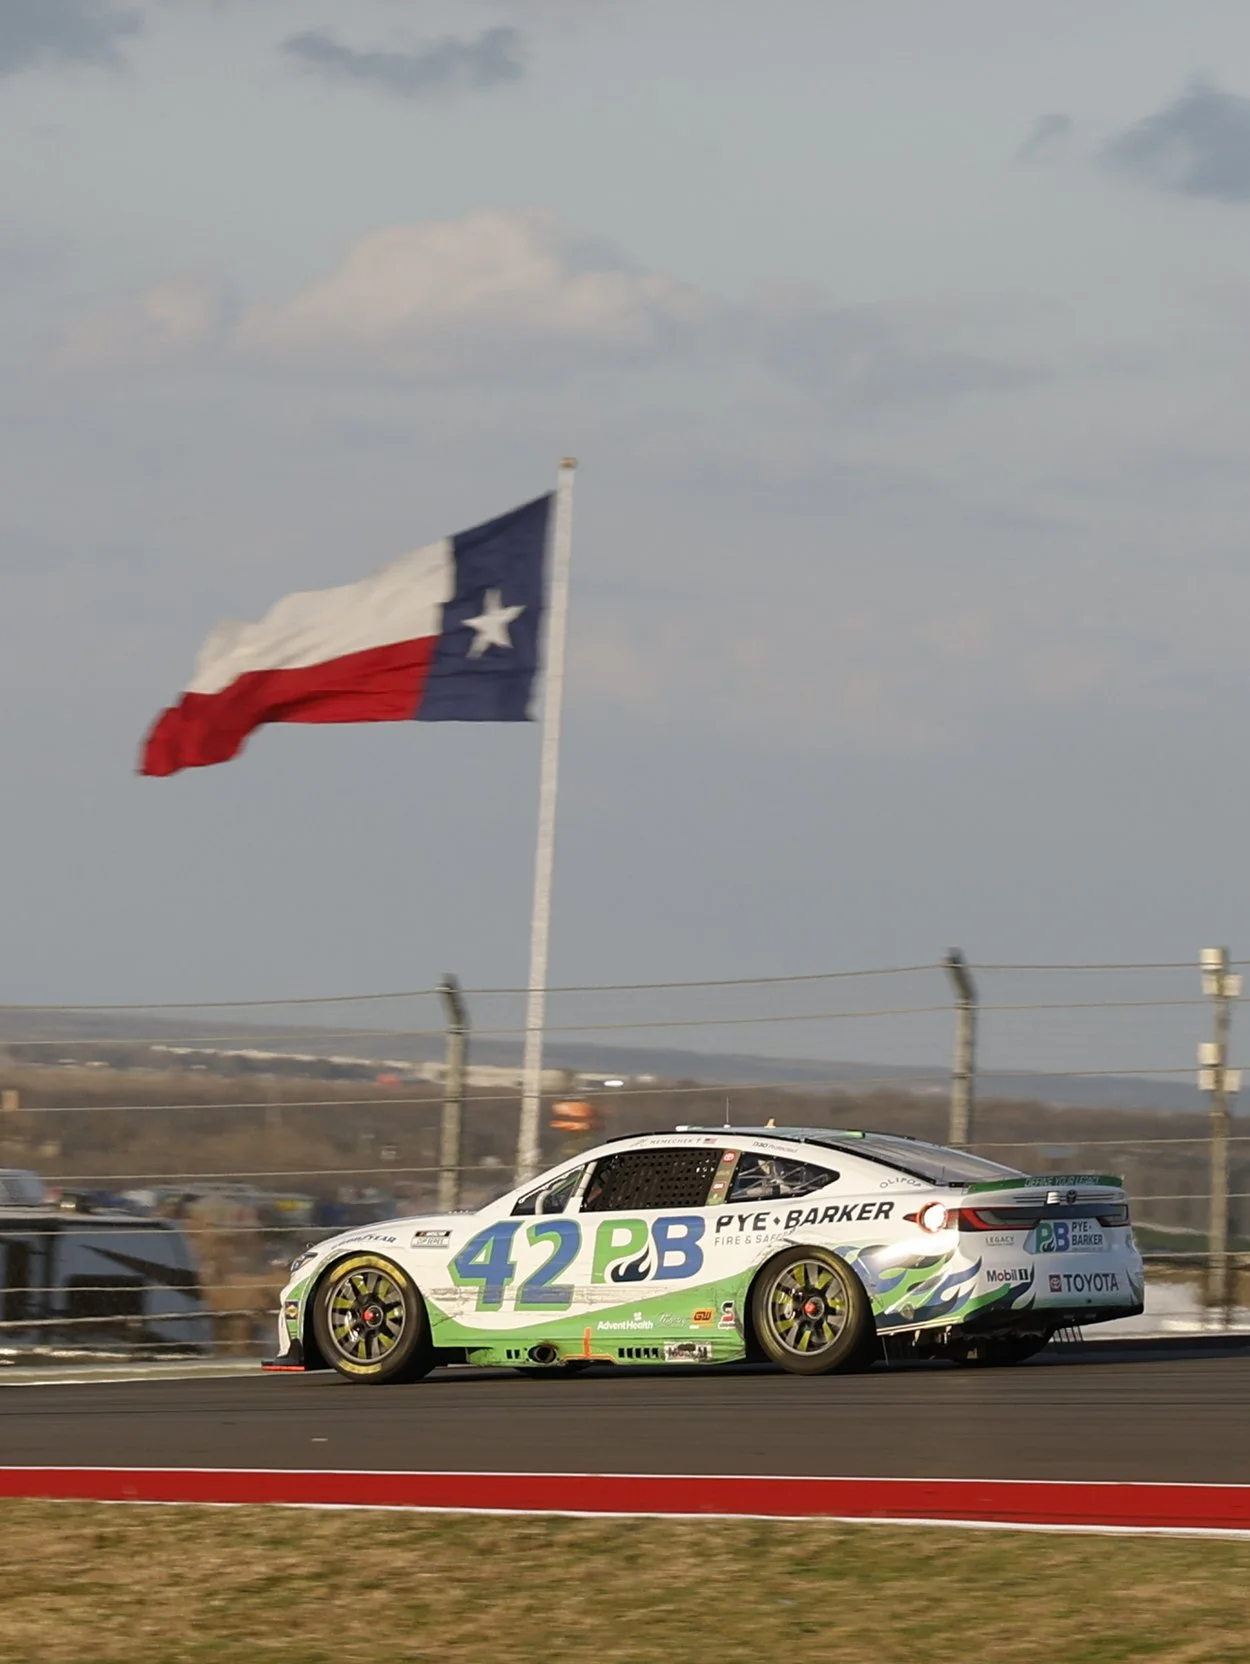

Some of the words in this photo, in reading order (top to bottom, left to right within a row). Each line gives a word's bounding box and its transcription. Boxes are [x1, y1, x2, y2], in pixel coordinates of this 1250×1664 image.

[1024, 1177, 1053, 1187] DEFINE
[1055, 1176, 1075, 1186] YOUR
[1075, 1175, 1101, 1186] LEGACY
[714, 1211, 770, 1233] PYE
[783, 1201, 895, 1230] BARKER
[714, 1236, 741, 1247] FIRE
[744, 1235, 752, 1244] &
[985, 1235, 1015, 1245] LEGACY
[1035, 1221, 1070, 1252] PB
[1071, 1233, 1103, 1246] BARKER
[590, 1215, 706, 1284] PB
[446, 1218, 583, 1312] 42
[986, 1268, 1018, 1283] Mobil
[1063, 1273, 1120, 1293] TOYOTA
[596, 1320, 654, 1331] AdventHealth
